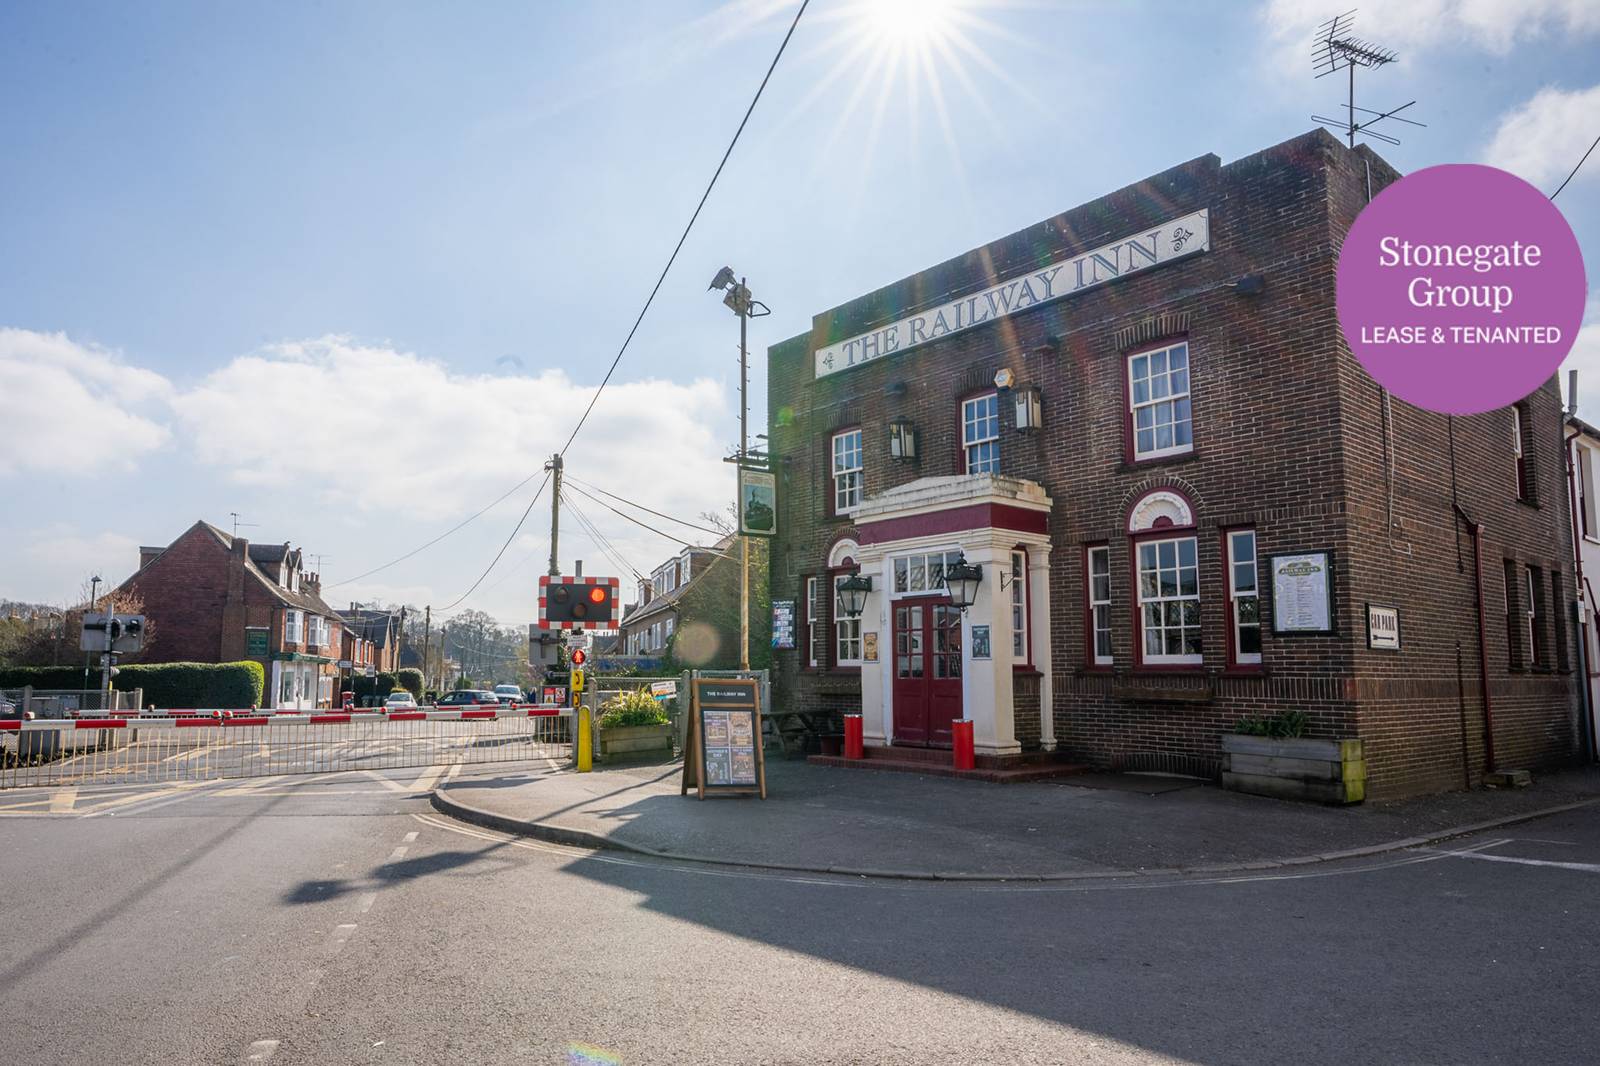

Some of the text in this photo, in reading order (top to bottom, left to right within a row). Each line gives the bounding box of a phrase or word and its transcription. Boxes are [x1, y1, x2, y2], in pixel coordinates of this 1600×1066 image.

[842, 230, 1161, 366] THE RAILWAY INN
[1381, 614, 1395, 631] PARK
